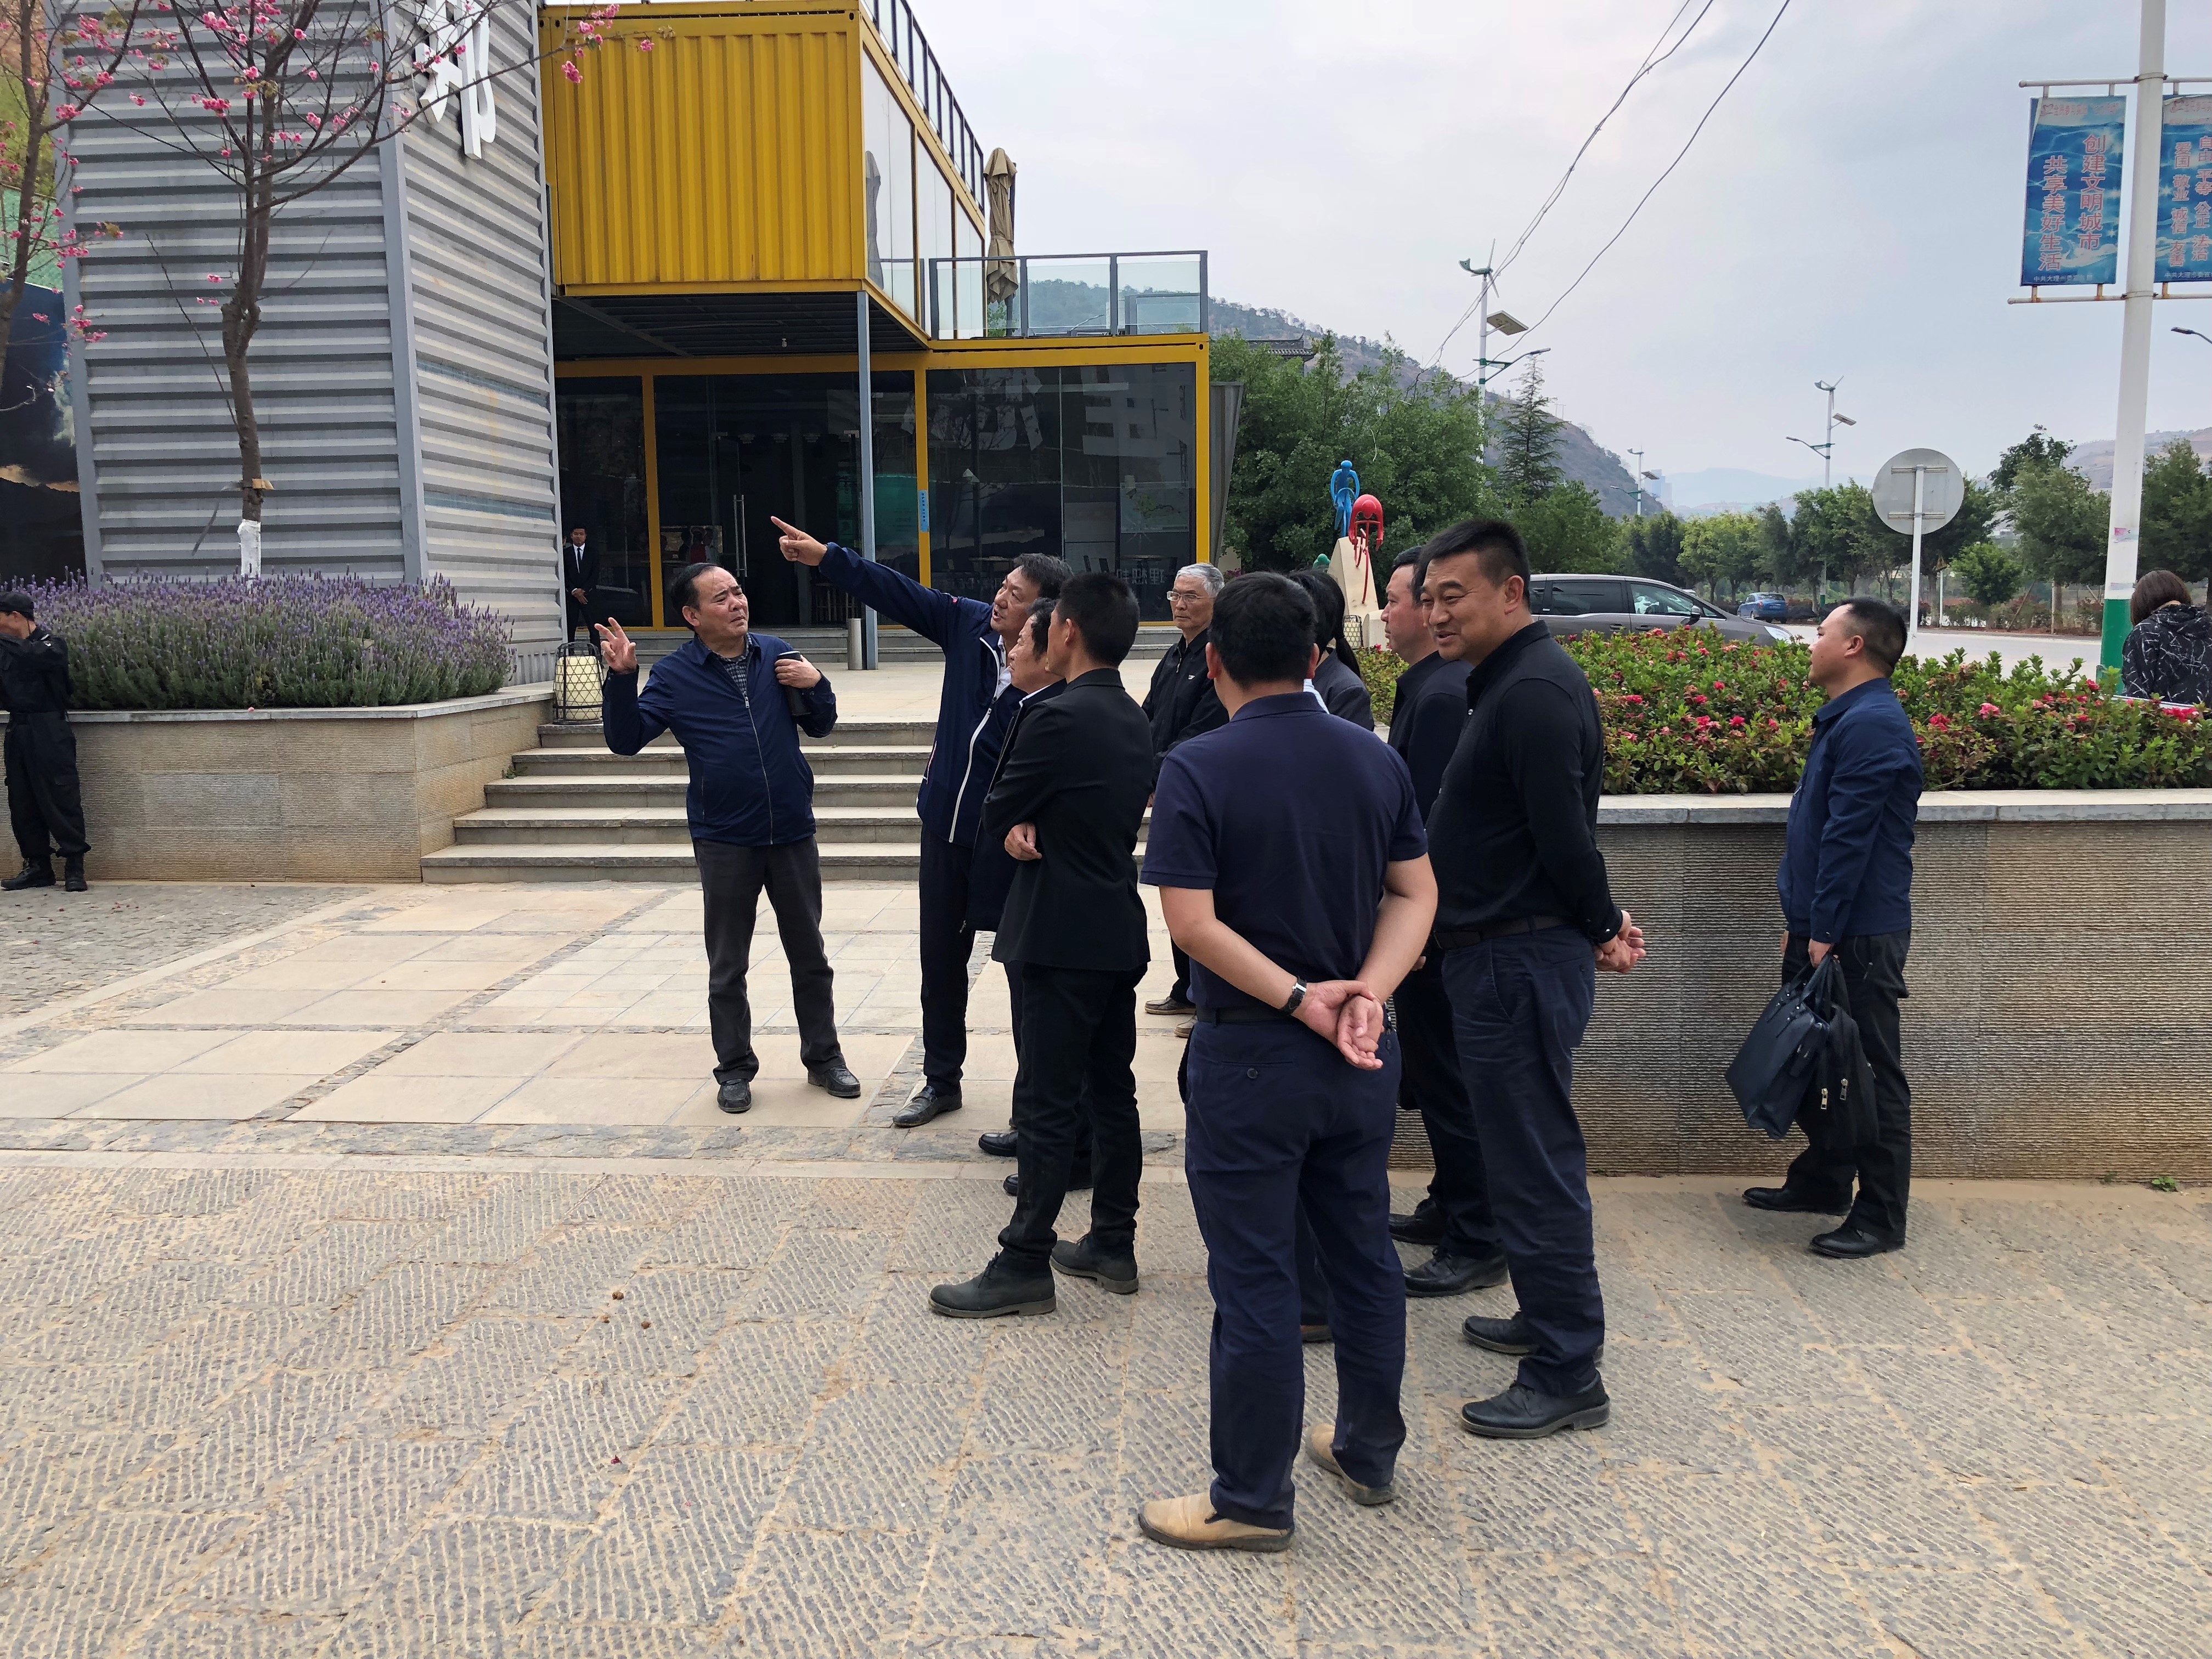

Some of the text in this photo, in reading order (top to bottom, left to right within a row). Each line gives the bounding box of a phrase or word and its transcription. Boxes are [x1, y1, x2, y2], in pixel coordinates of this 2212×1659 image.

[2174, 141, 2192, 169] 爱国
[2078, 134, 2107, 251] 创建文明城市
[2172, 174, 2191, 201] 敬业
[2191, 136, 2212, 261] 自由 平等 公正 法治
[2038, 155, 2068, 271] 共享美好生活
[2171, 207, 2188, 234] 诚信
[2168, 240, 2186, 267] 友善
